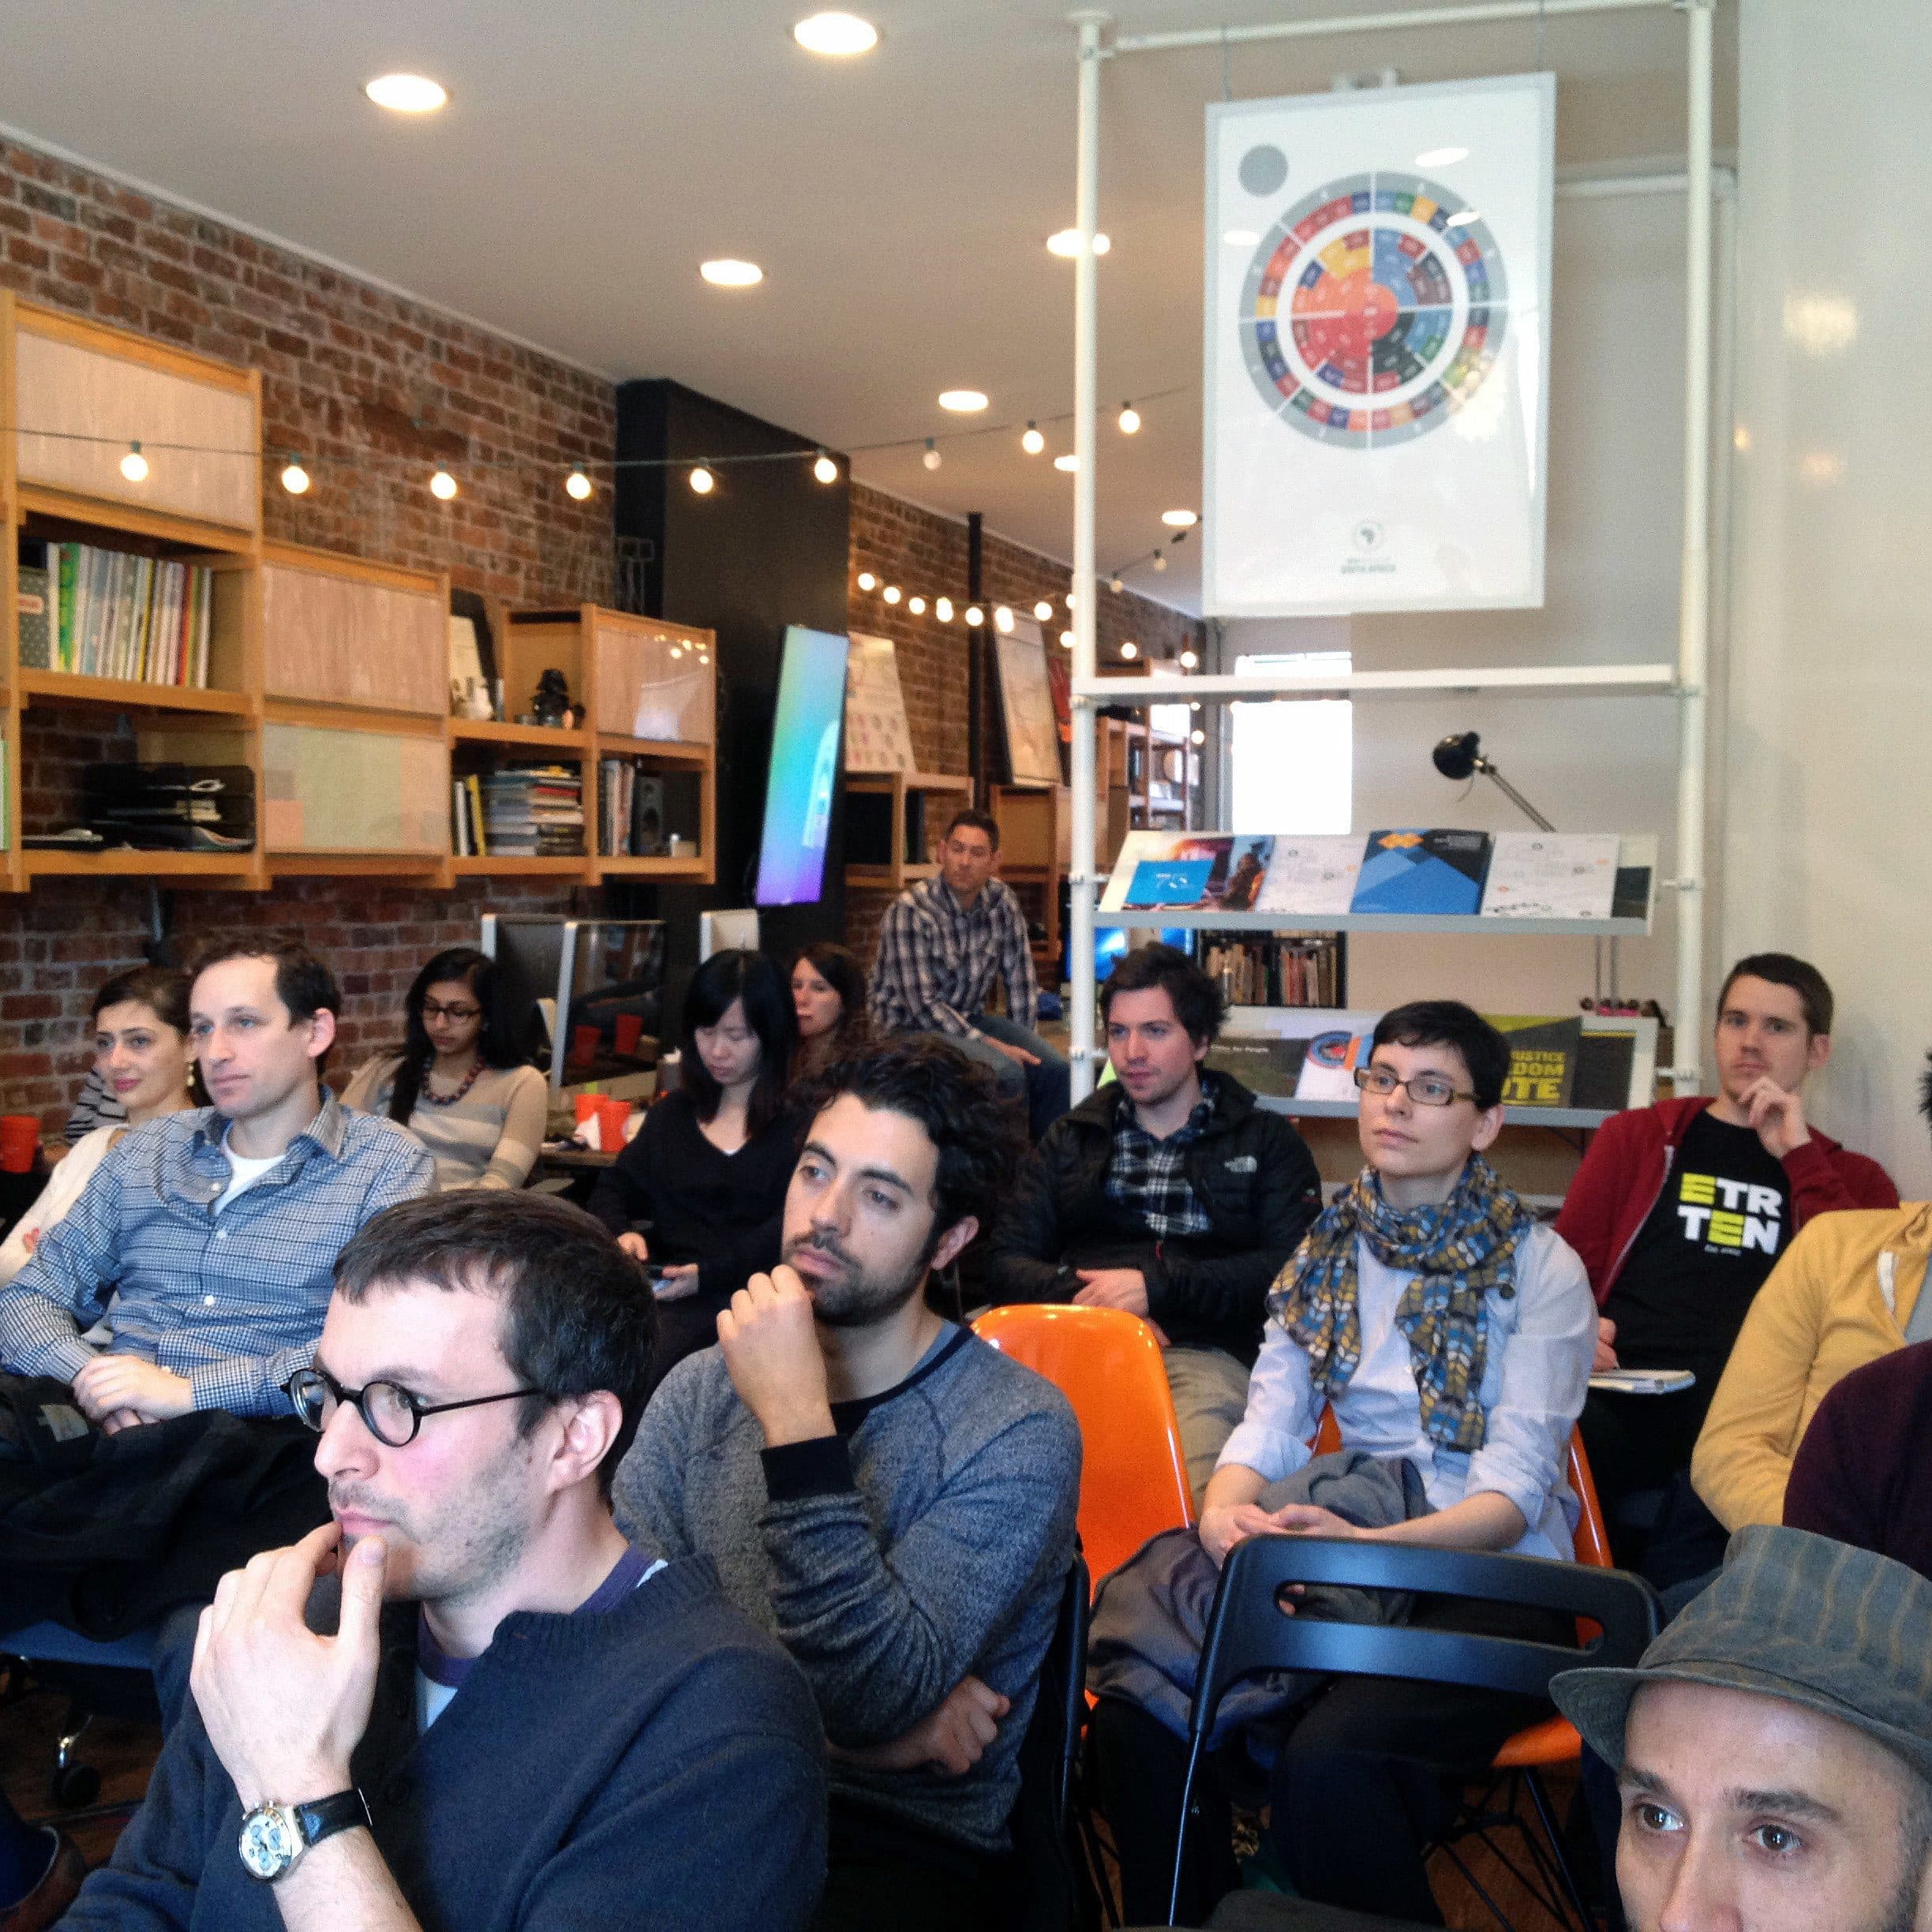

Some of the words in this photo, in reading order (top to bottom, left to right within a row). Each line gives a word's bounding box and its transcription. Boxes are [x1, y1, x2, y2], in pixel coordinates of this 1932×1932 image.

[1509, 1062, 1565, 1076] DOM
[1679, 1172, 1783, 1217] ETR
[1677, 1204, 1780, 1256] TEN
